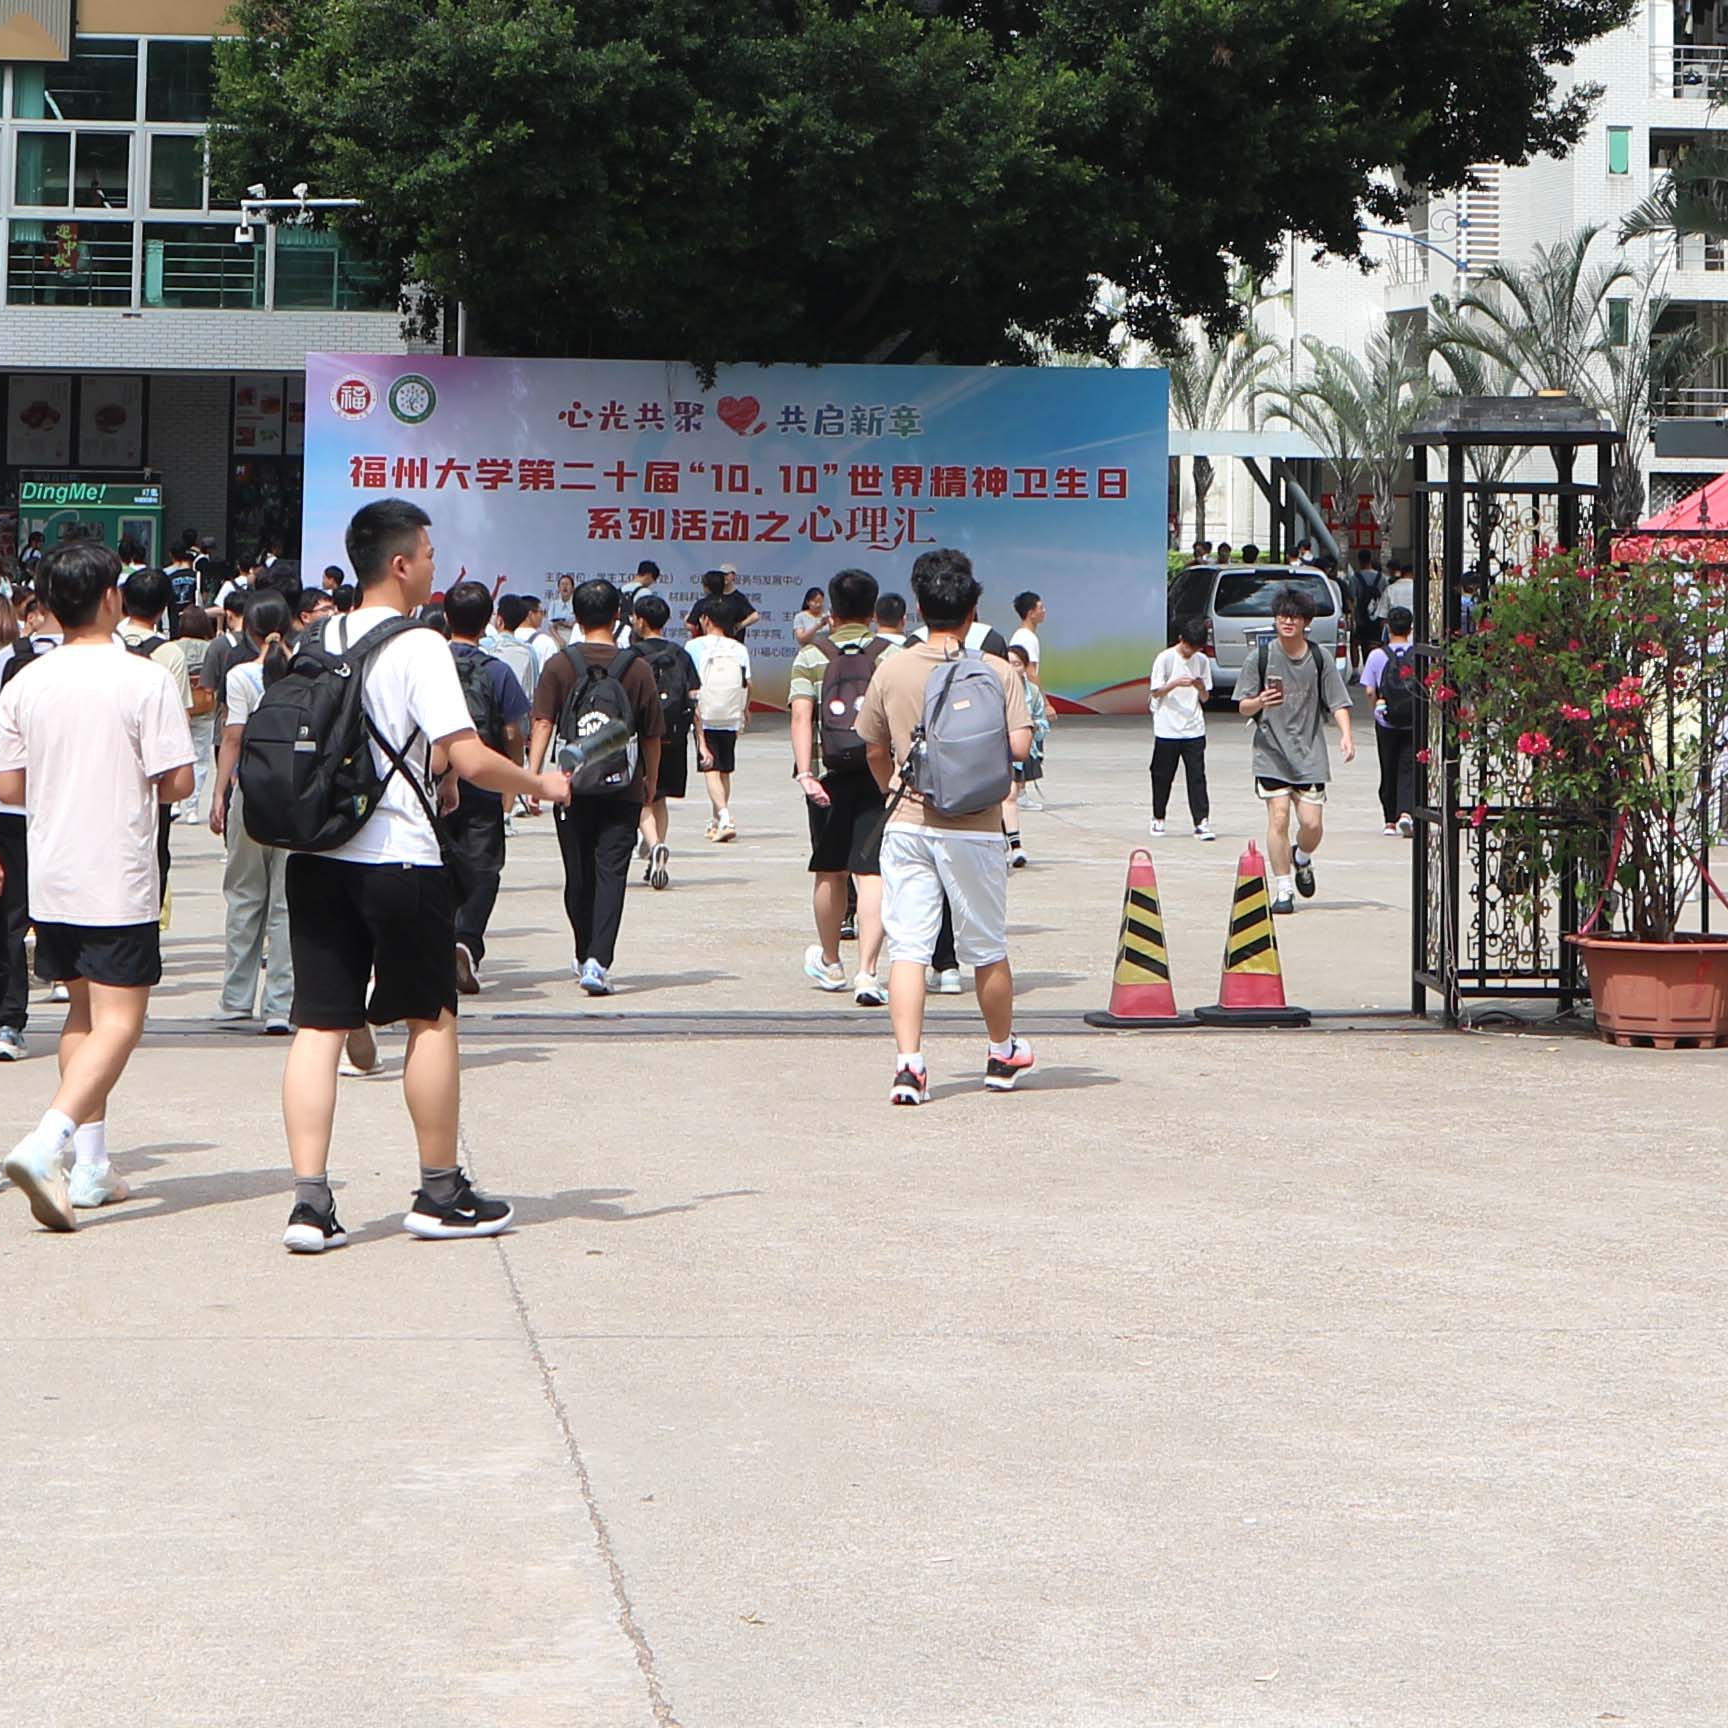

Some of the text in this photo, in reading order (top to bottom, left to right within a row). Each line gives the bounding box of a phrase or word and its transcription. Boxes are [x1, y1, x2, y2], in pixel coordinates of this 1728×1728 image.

[557, 400, 925, 438] 心光共聚 共启新章
[21, 481, 107, 505] DingMe!
